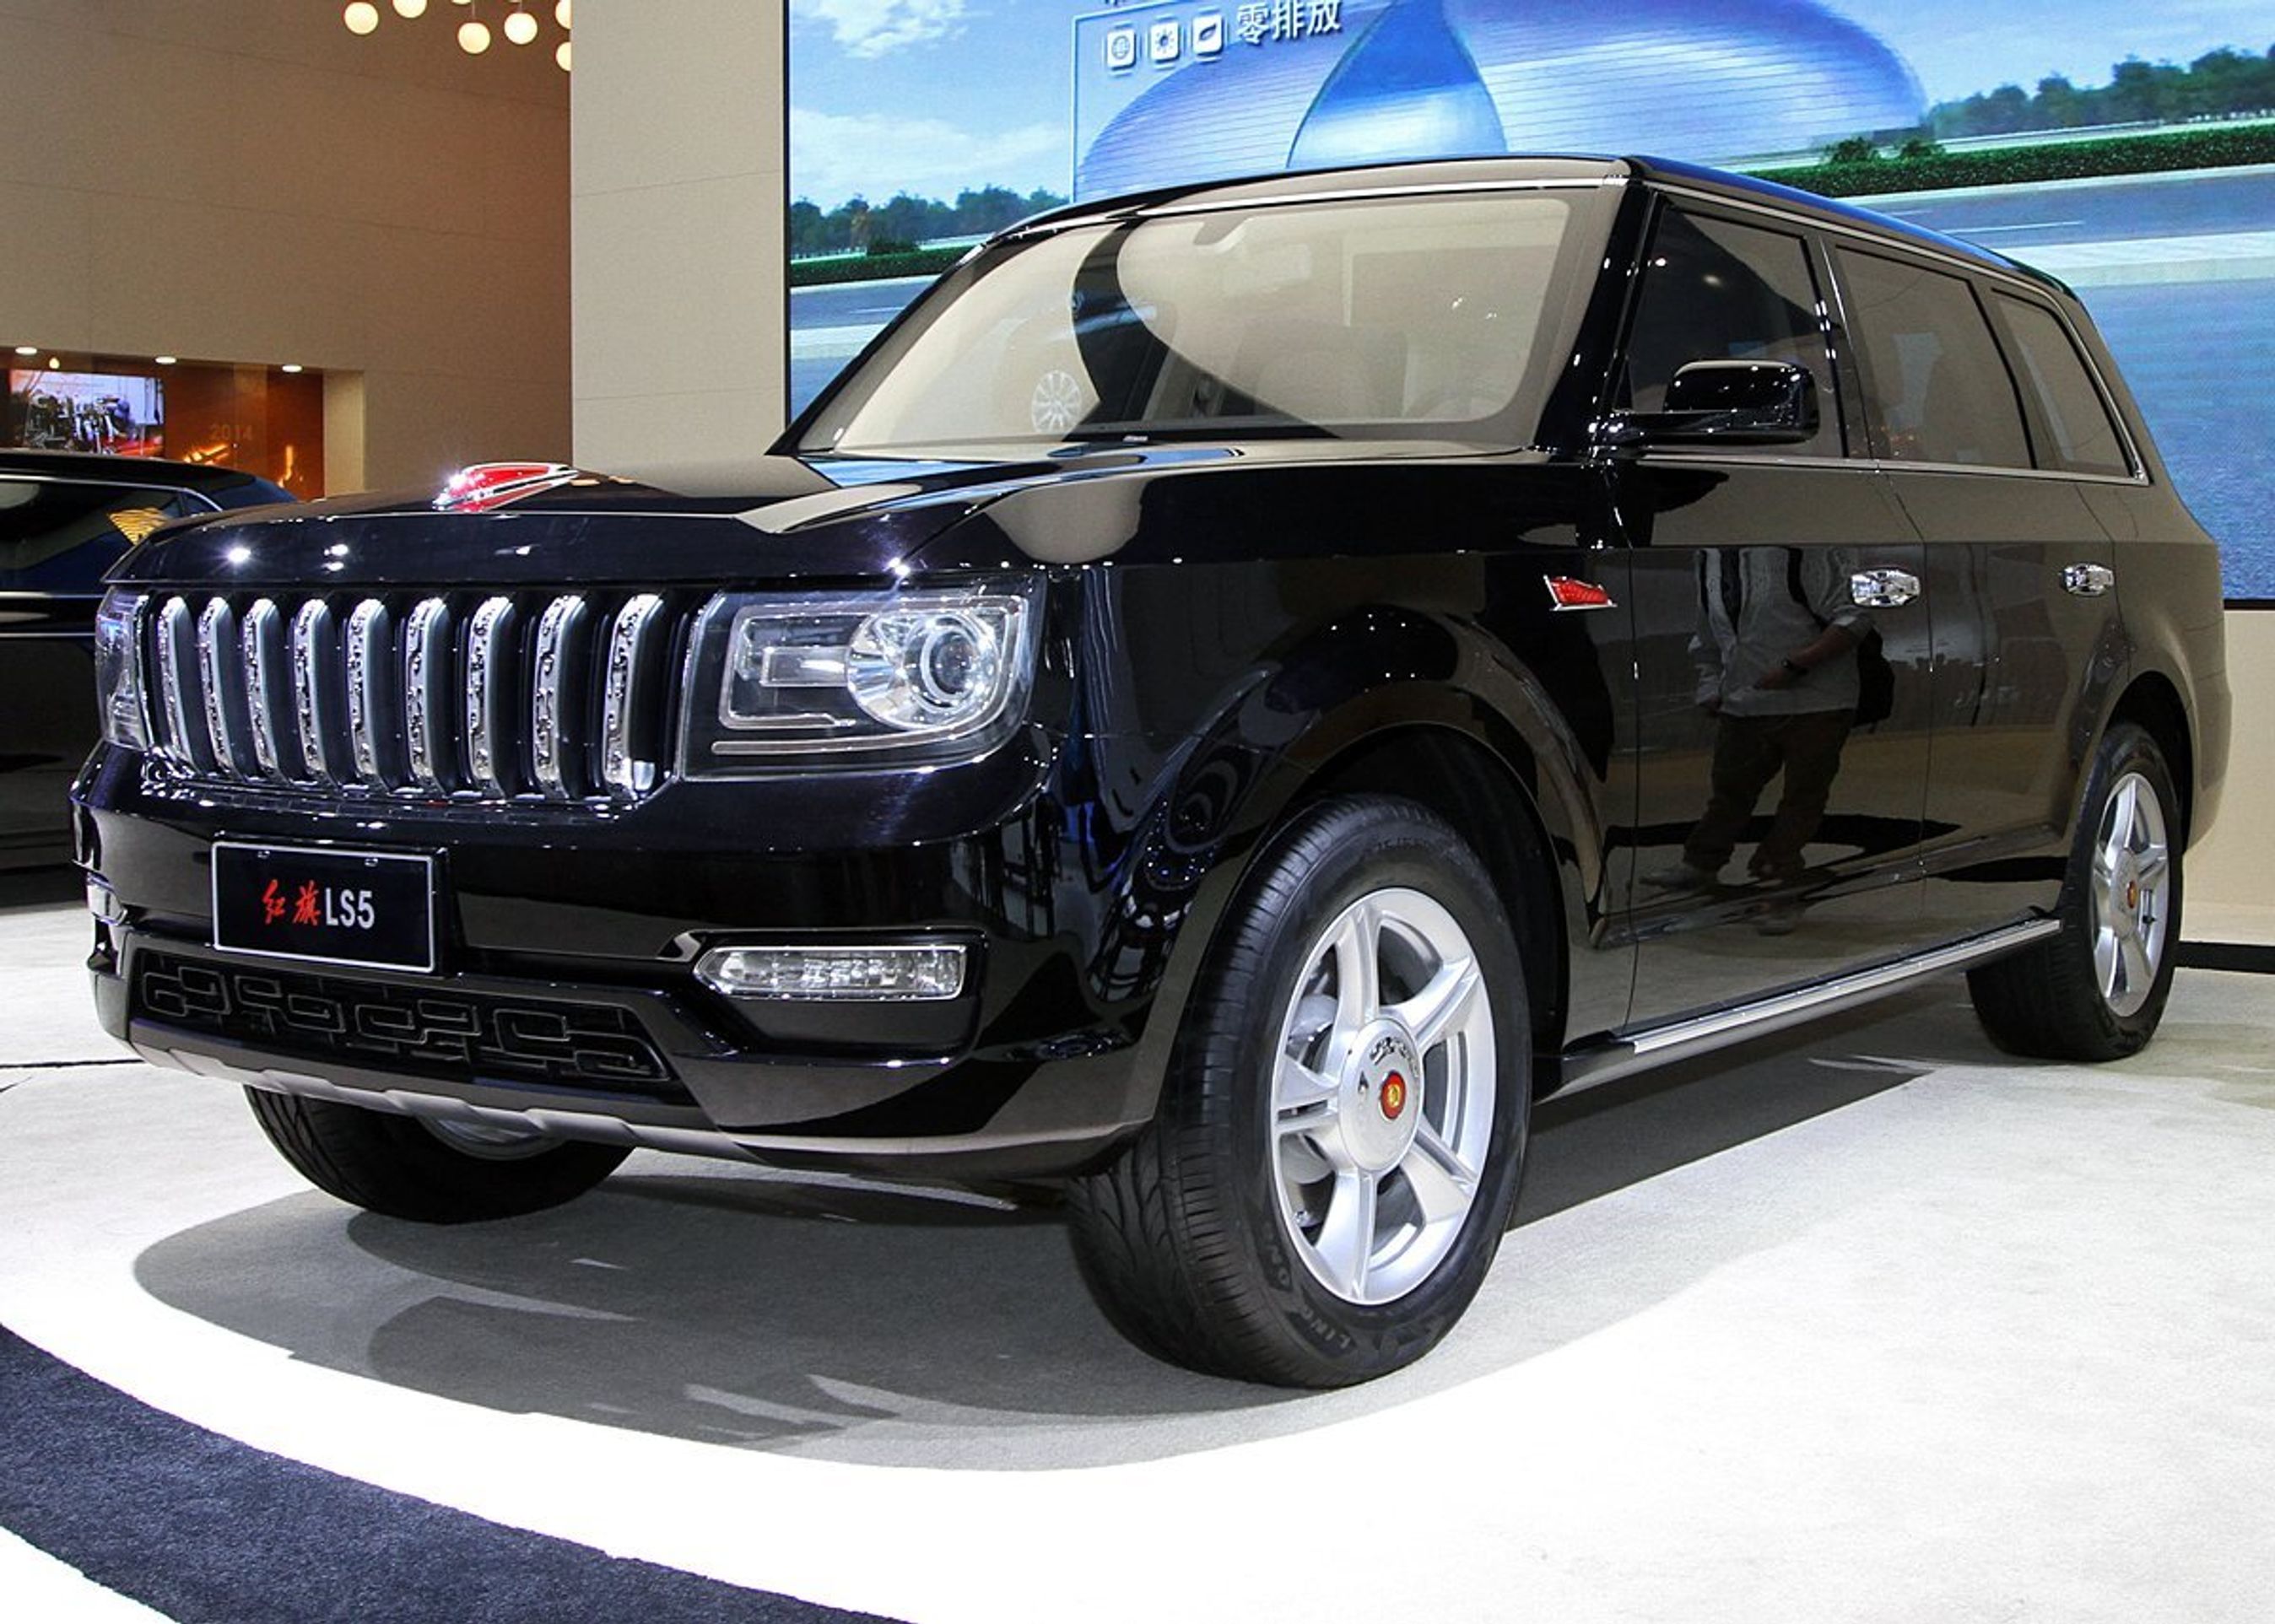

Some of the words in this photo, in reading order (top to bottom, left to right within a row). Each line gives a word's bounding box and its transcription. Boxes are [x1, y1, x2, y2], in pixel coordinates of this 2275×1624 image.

[1235, 0, 1341, 44] 零排放
[209, 424, 253, 441] 2014
[325, 887, 375, 929] LS5
